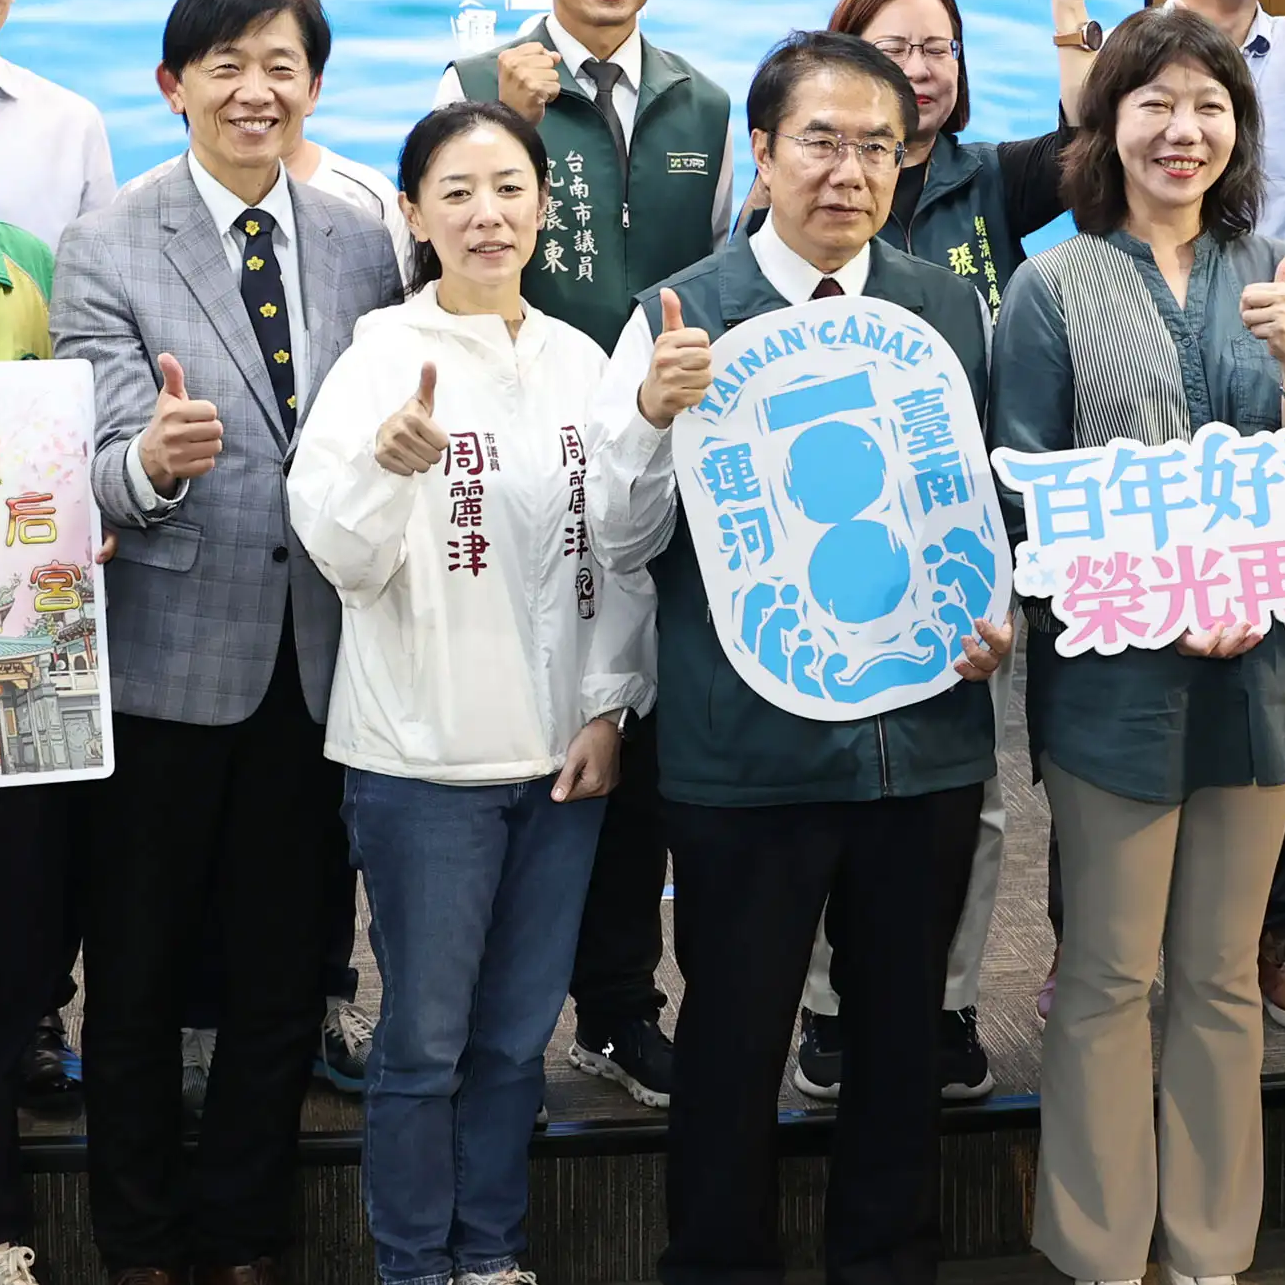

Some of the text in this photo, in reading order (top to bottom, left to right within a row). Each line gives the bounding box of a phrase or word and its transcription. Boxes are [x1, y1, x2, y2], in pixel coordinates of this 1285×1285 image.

[565, 150, 599, 283] 台南市議員
[947, 242, 979, 276] 張
[697, 314, 927, 418] TAINAN CANAL
[443, 432, 491, 578] 周麗津
[483, 432, 501, 473] 市議員
[700, 442, 775, 572] 運河
[892, 387, 970, 516] 臺南
